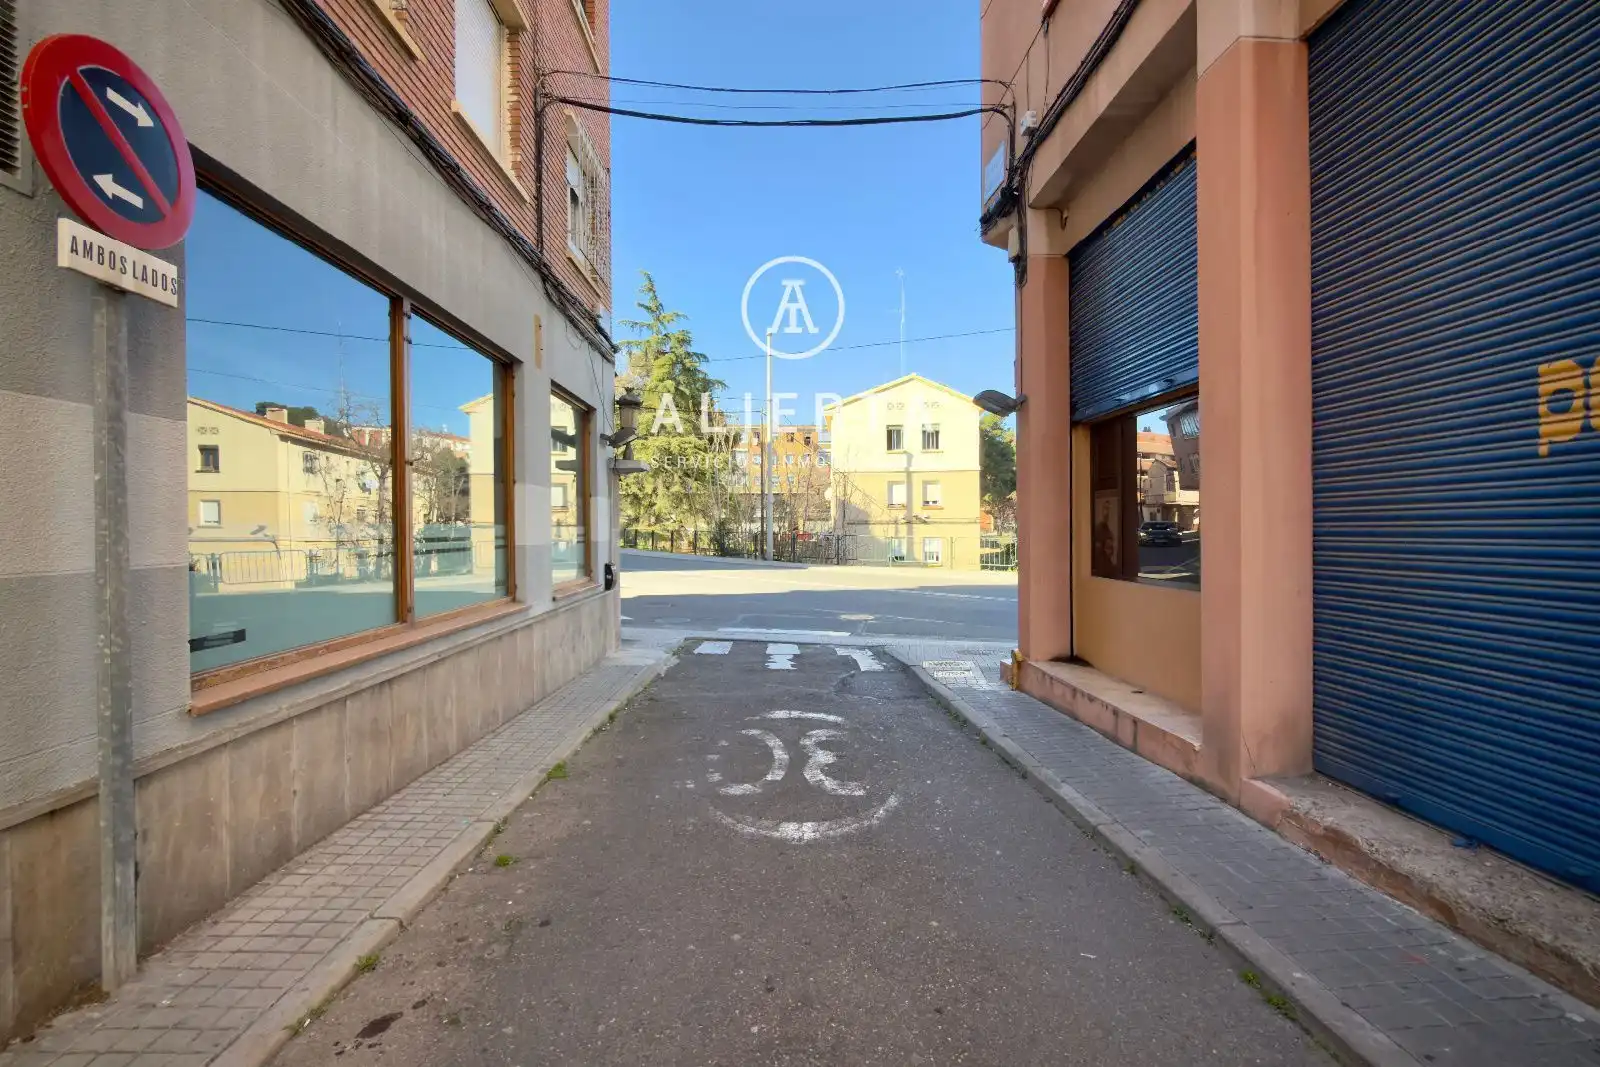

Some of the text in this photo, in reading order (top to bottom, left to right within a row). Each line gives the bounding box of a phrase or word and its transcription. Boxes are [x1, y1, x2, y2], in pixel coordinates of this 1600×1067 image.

[70, 235, 177, 295] AMBOS LADOS
[1538, 356, 1600, 457] p
